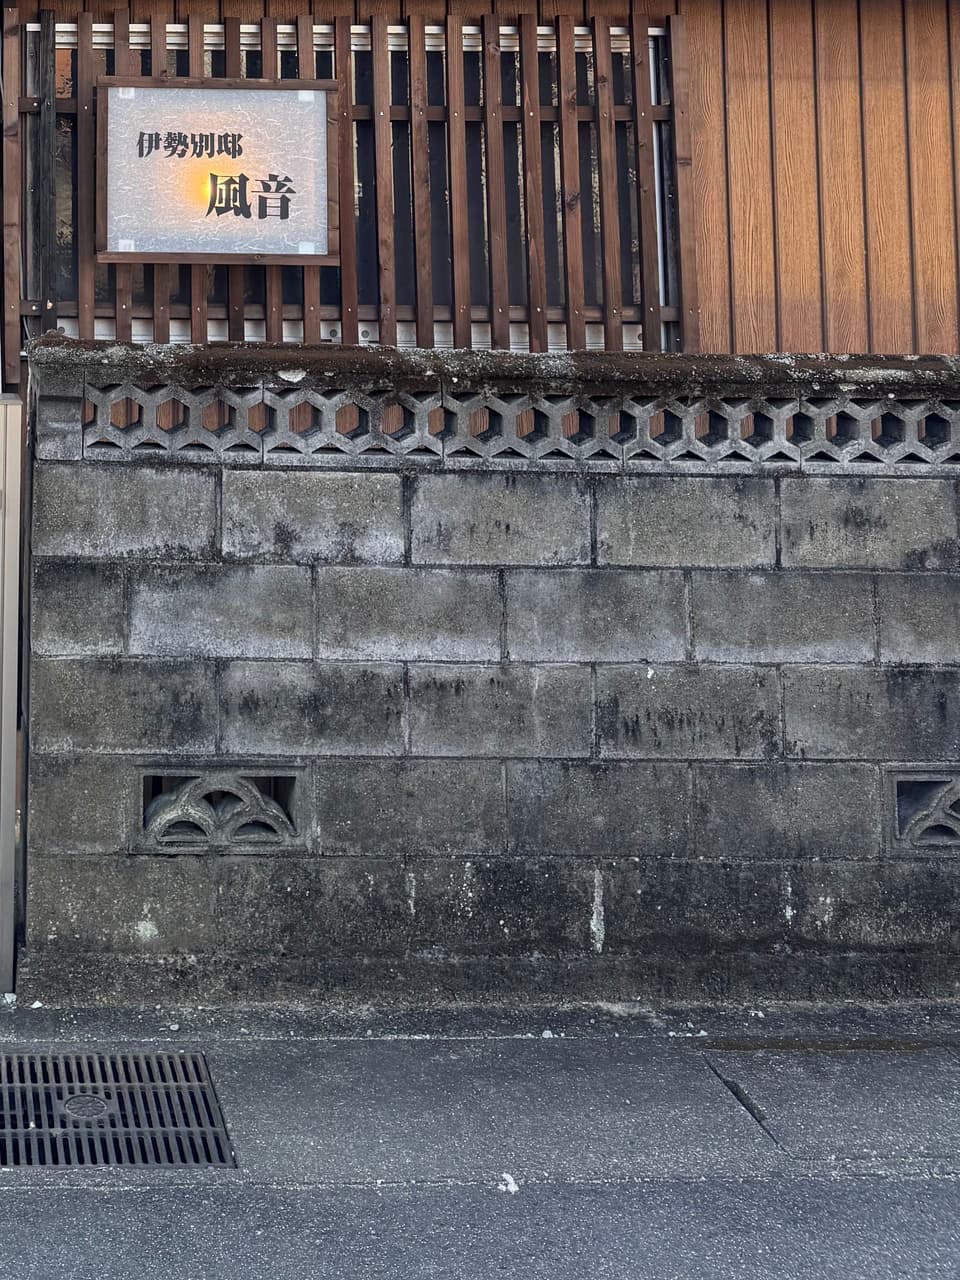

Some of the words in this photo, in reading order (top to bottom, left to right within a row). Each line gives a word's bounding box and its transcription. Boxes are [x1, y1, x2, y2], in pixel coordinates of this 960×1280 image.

[136, 131, 244, 159] 伊勢別邸
[206, 172, 297, 220] 風音
